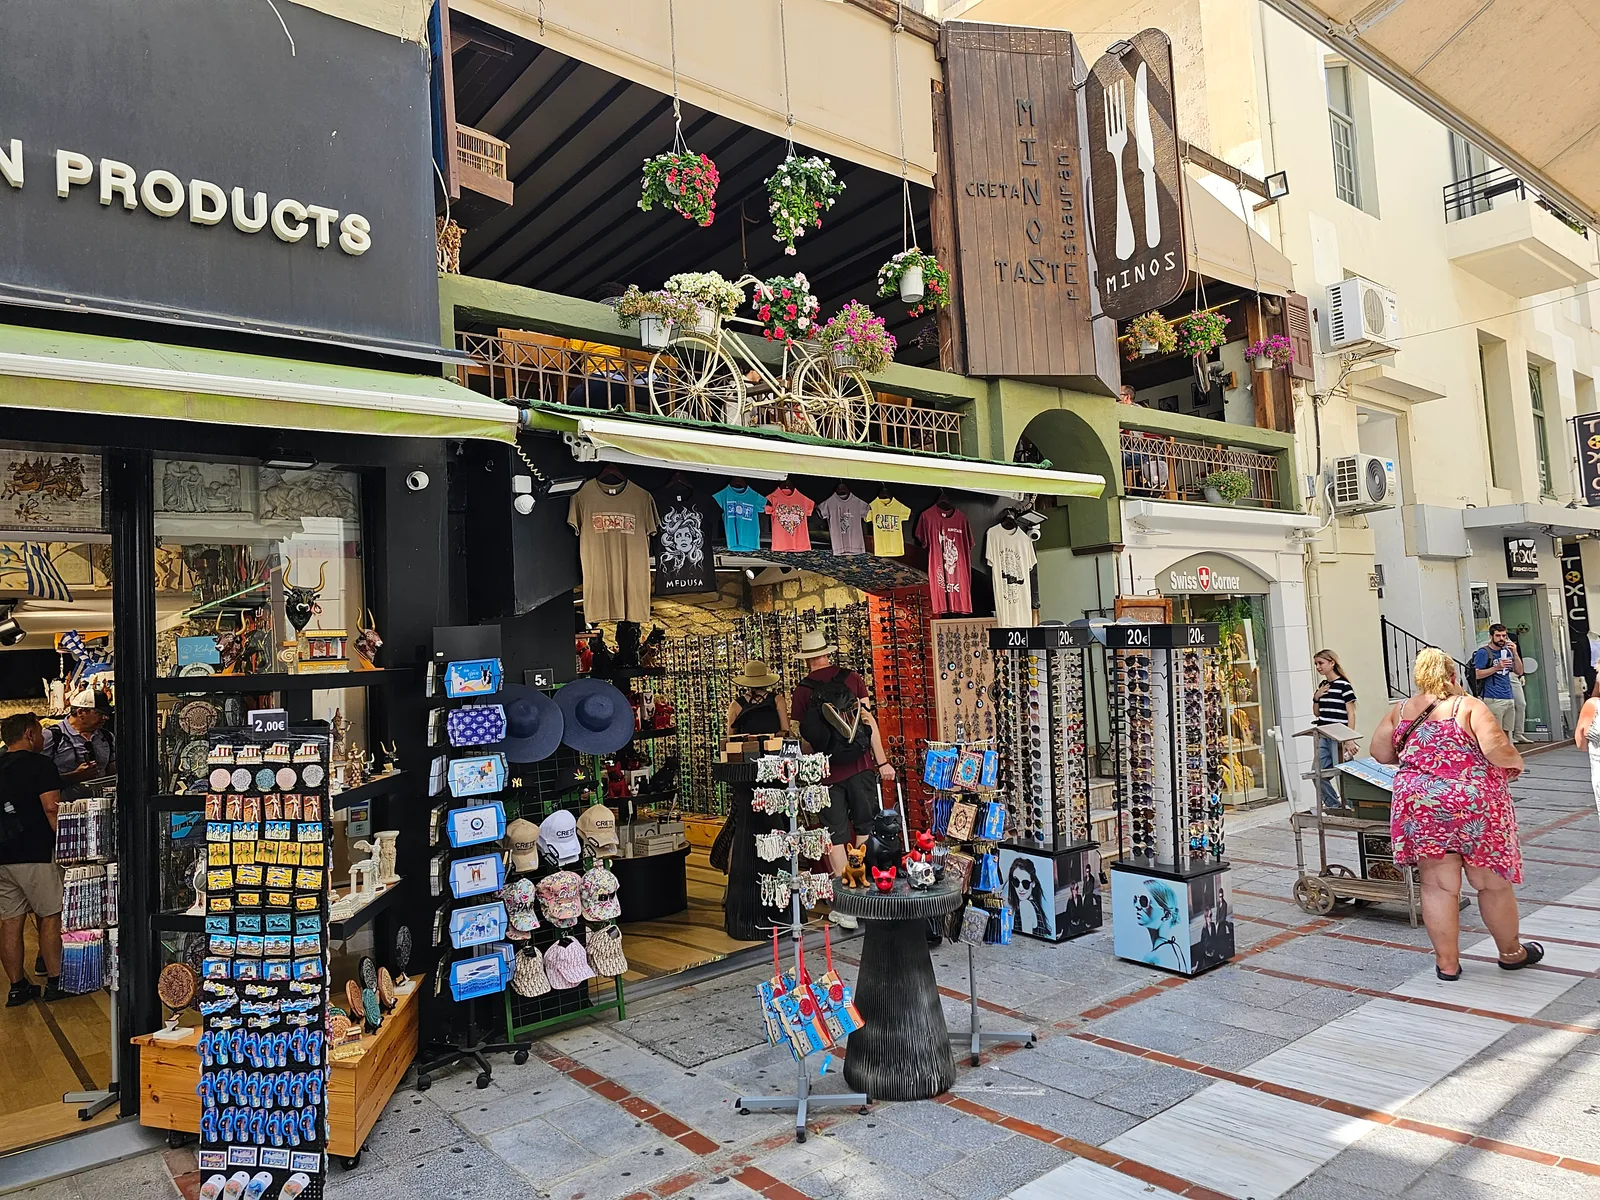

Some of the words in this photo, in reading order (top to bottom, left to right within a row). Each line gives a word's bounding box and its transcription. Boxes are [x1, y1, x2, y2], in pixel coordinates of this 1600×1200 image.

[965, 177, 1042, 207] CRETAN
[56, 148, 372, 257] PRODUCTS
[994, 256, 1079, 286] TASTE
[1106, 251, 1177, 296] MINOS
[665, 578, 704, 589] MEDUSA
[1170, 570, 1198, 590] Swiss
[1211, 573, 1240, 590] Corner
[1008, 631, 1026, 646] 20€
[1059, 630, 1074, 645] 20€
[1127, 628, 1148, 646] 20€
[1189, 627, 1206, 644] 20€
[534, 674, 548, 687] 5€
[254, 719, 285, 733] 2,00€
[782, 743, 798, 755] 1,50€
[511, 777, 523, 788] NY
